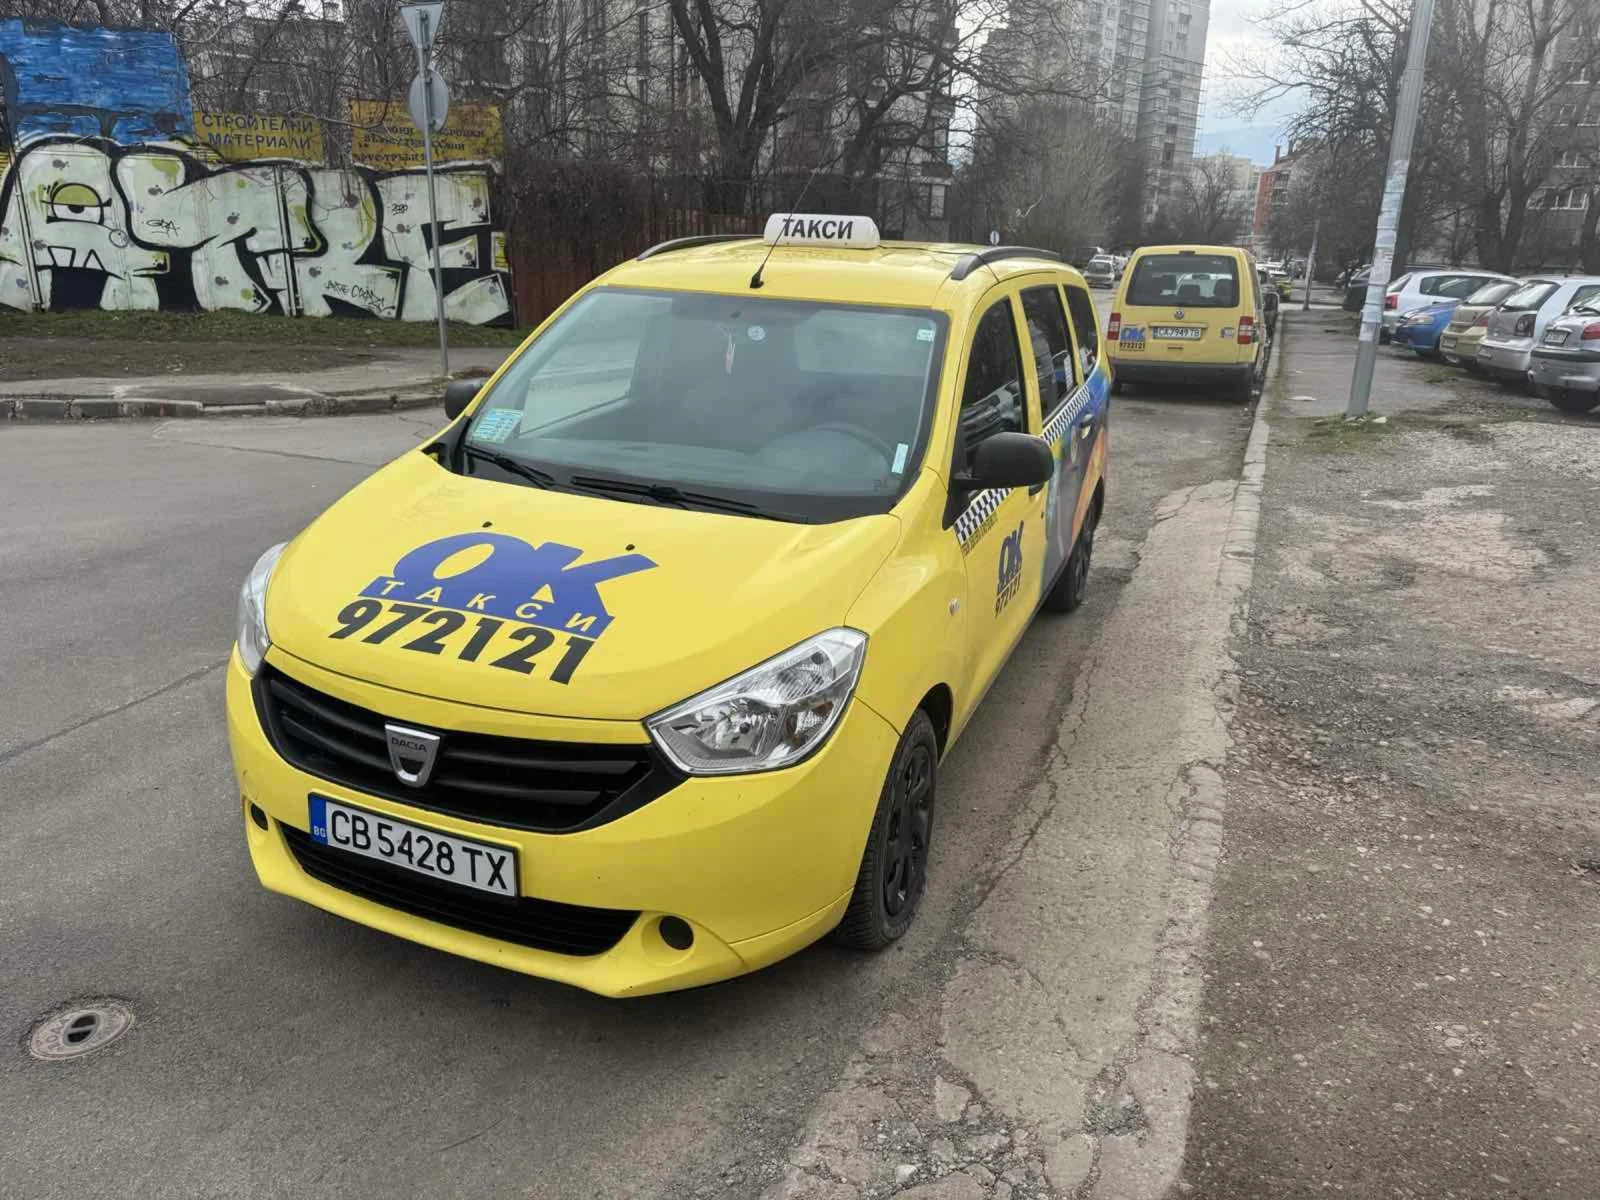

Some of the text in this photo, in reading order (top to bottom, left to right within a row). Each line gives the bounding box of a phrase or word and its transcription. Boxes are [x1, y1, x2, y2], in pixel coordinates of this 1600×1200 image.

[201, 113, 314, 133] СТРОИТЕЛНИ
[207, 132, 311, 150] МАТЕРИАЛИ
[782, 218, 854, 240] ТАКСИ
[390, 531, 660, 620] OK
[380, 579, 598, 632] ТАКСИ
[995, 573, 1021, 619] 972121
[327, 599, 596, 685] 972121
[391, 737, 428, 752] DACIA
[313, 825, 327, 838] BG
